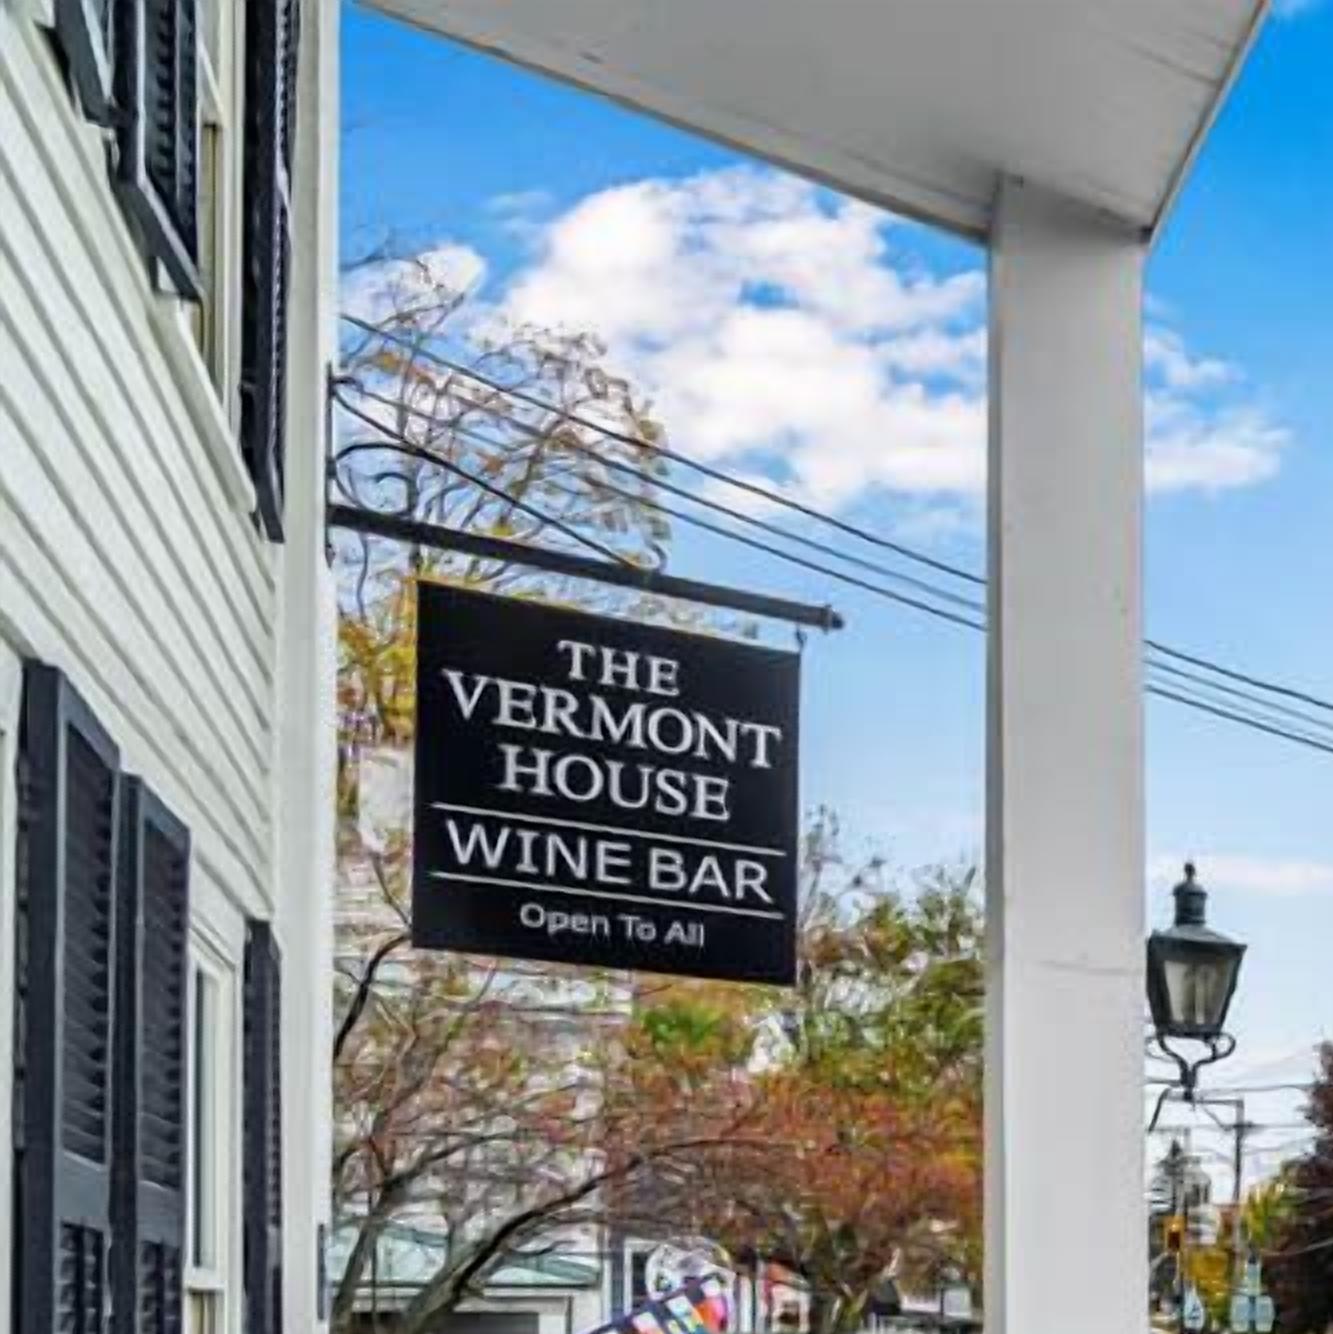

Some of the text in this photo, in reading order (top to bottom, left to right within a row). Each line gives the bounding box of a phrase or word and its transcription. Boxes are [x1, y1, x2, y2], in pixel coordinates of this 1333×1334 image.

[558, 640, 680, 696] THE
[442, 668, 782, 768] VERMONT
[499, 743, 731, 821] HOUSE
[447, 819, 774, 905] WINE BAR
[520, 902, 705, 947] Open To All
